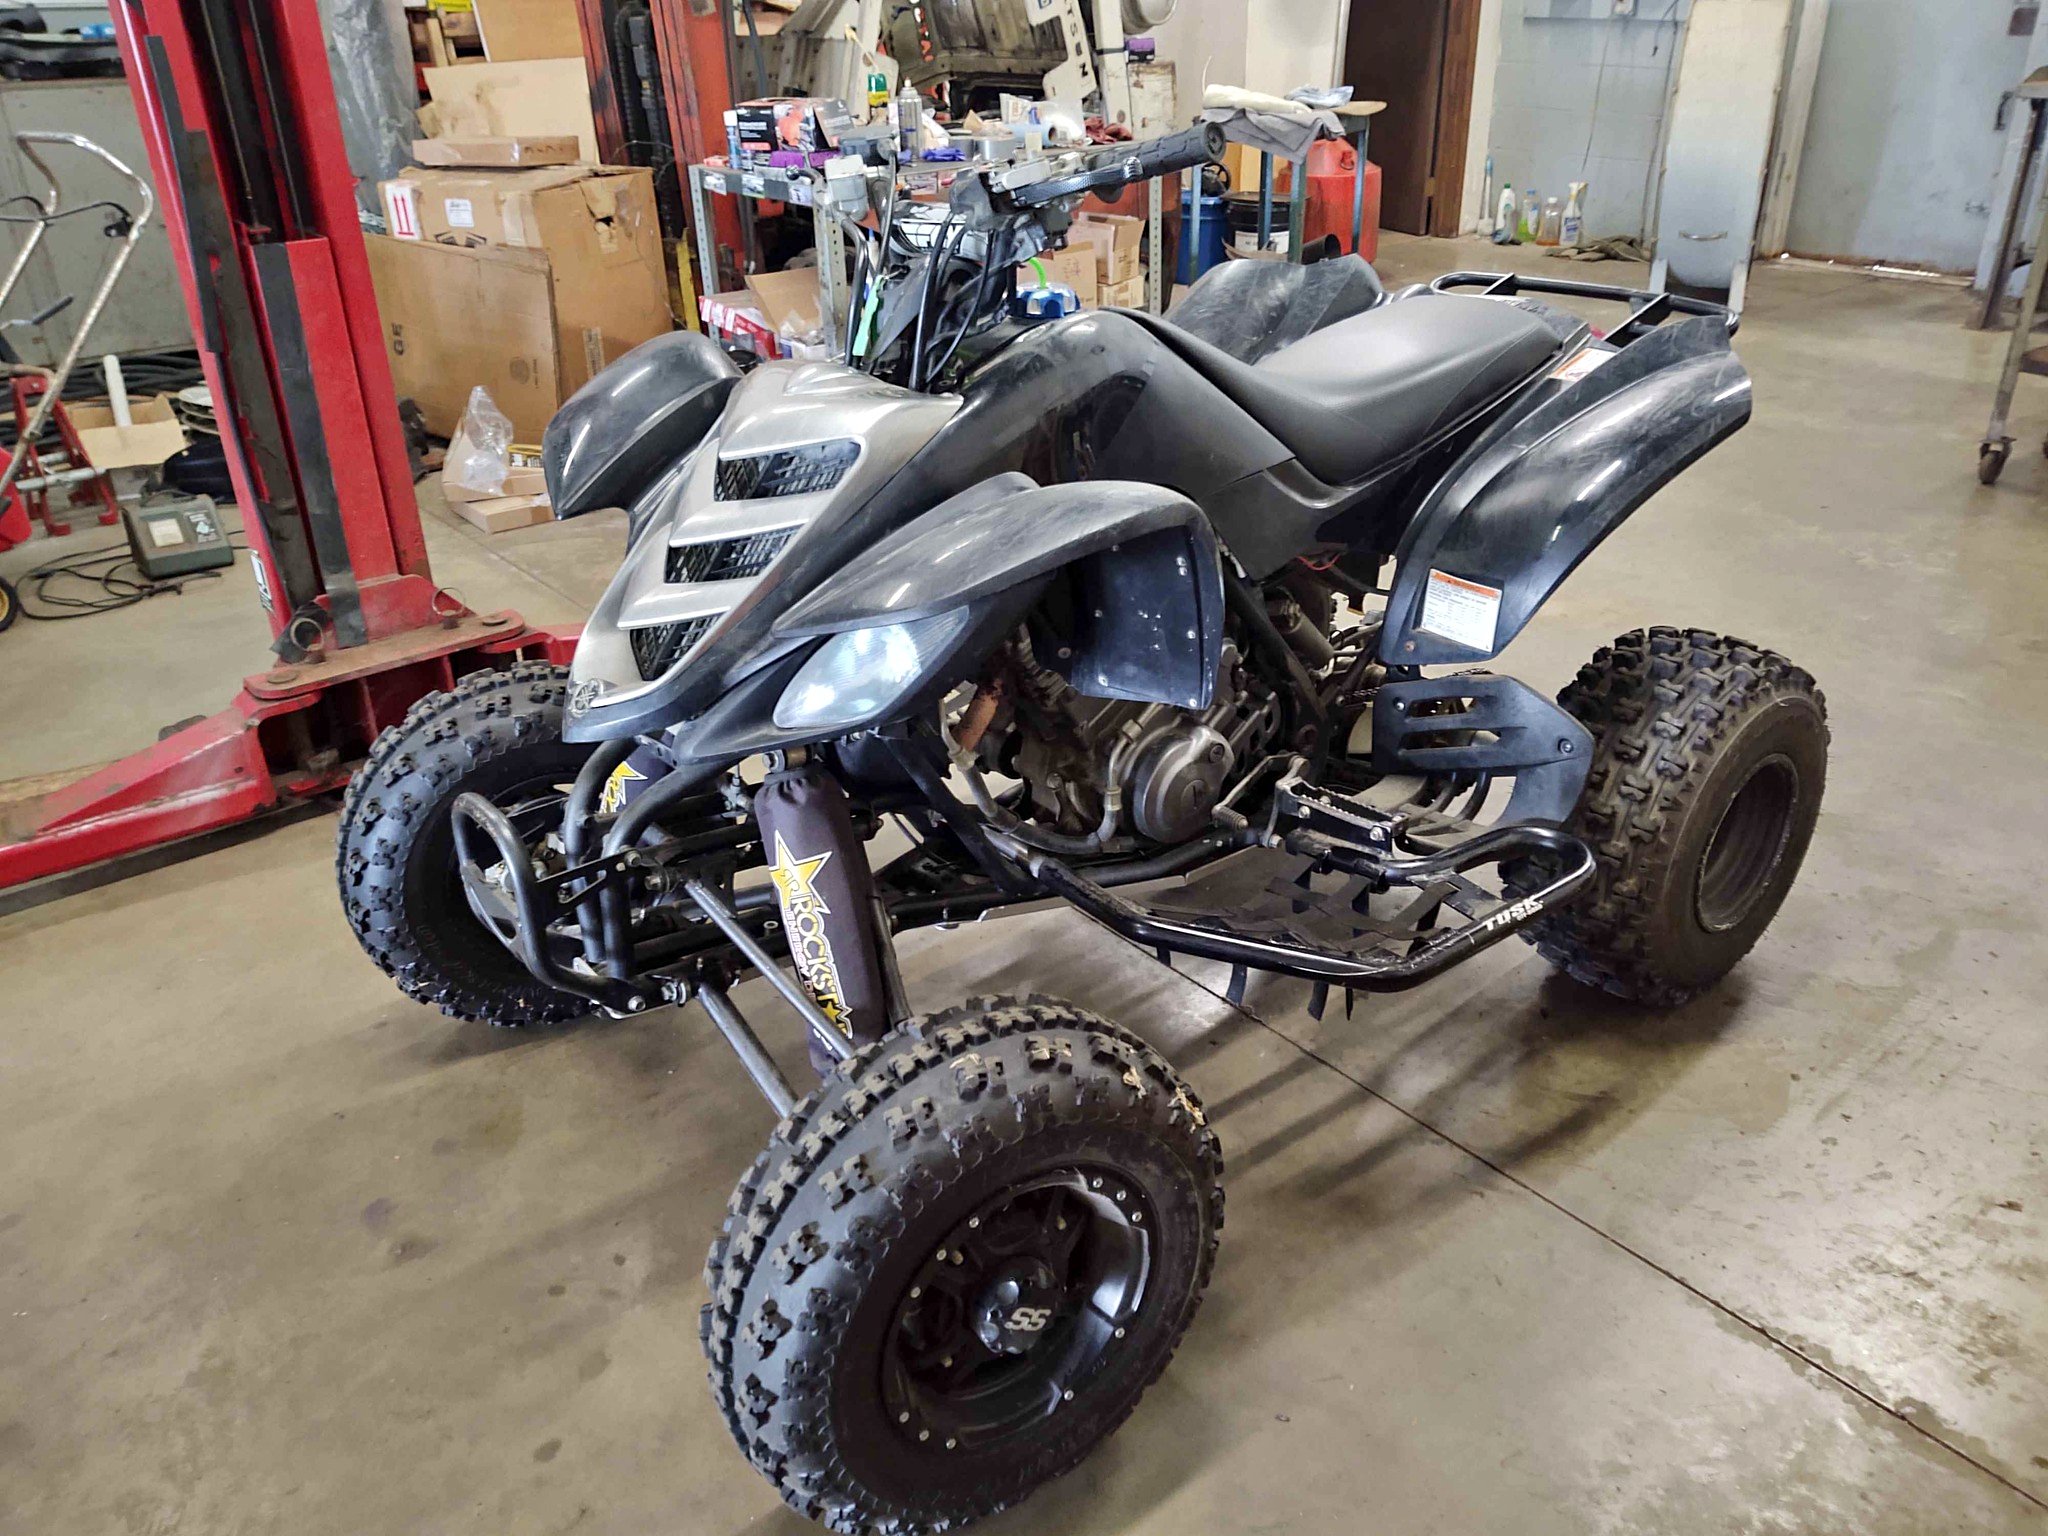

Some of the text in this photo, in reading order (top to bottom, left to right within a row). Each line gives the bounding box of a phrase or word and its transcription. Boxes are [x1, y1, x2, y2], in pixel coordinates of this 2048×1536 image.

[1482, 895, 1540, 931] TUSK
[785, 909, 811, 978] ENERGY
[1004, 1307, 1052, 1331] SS
